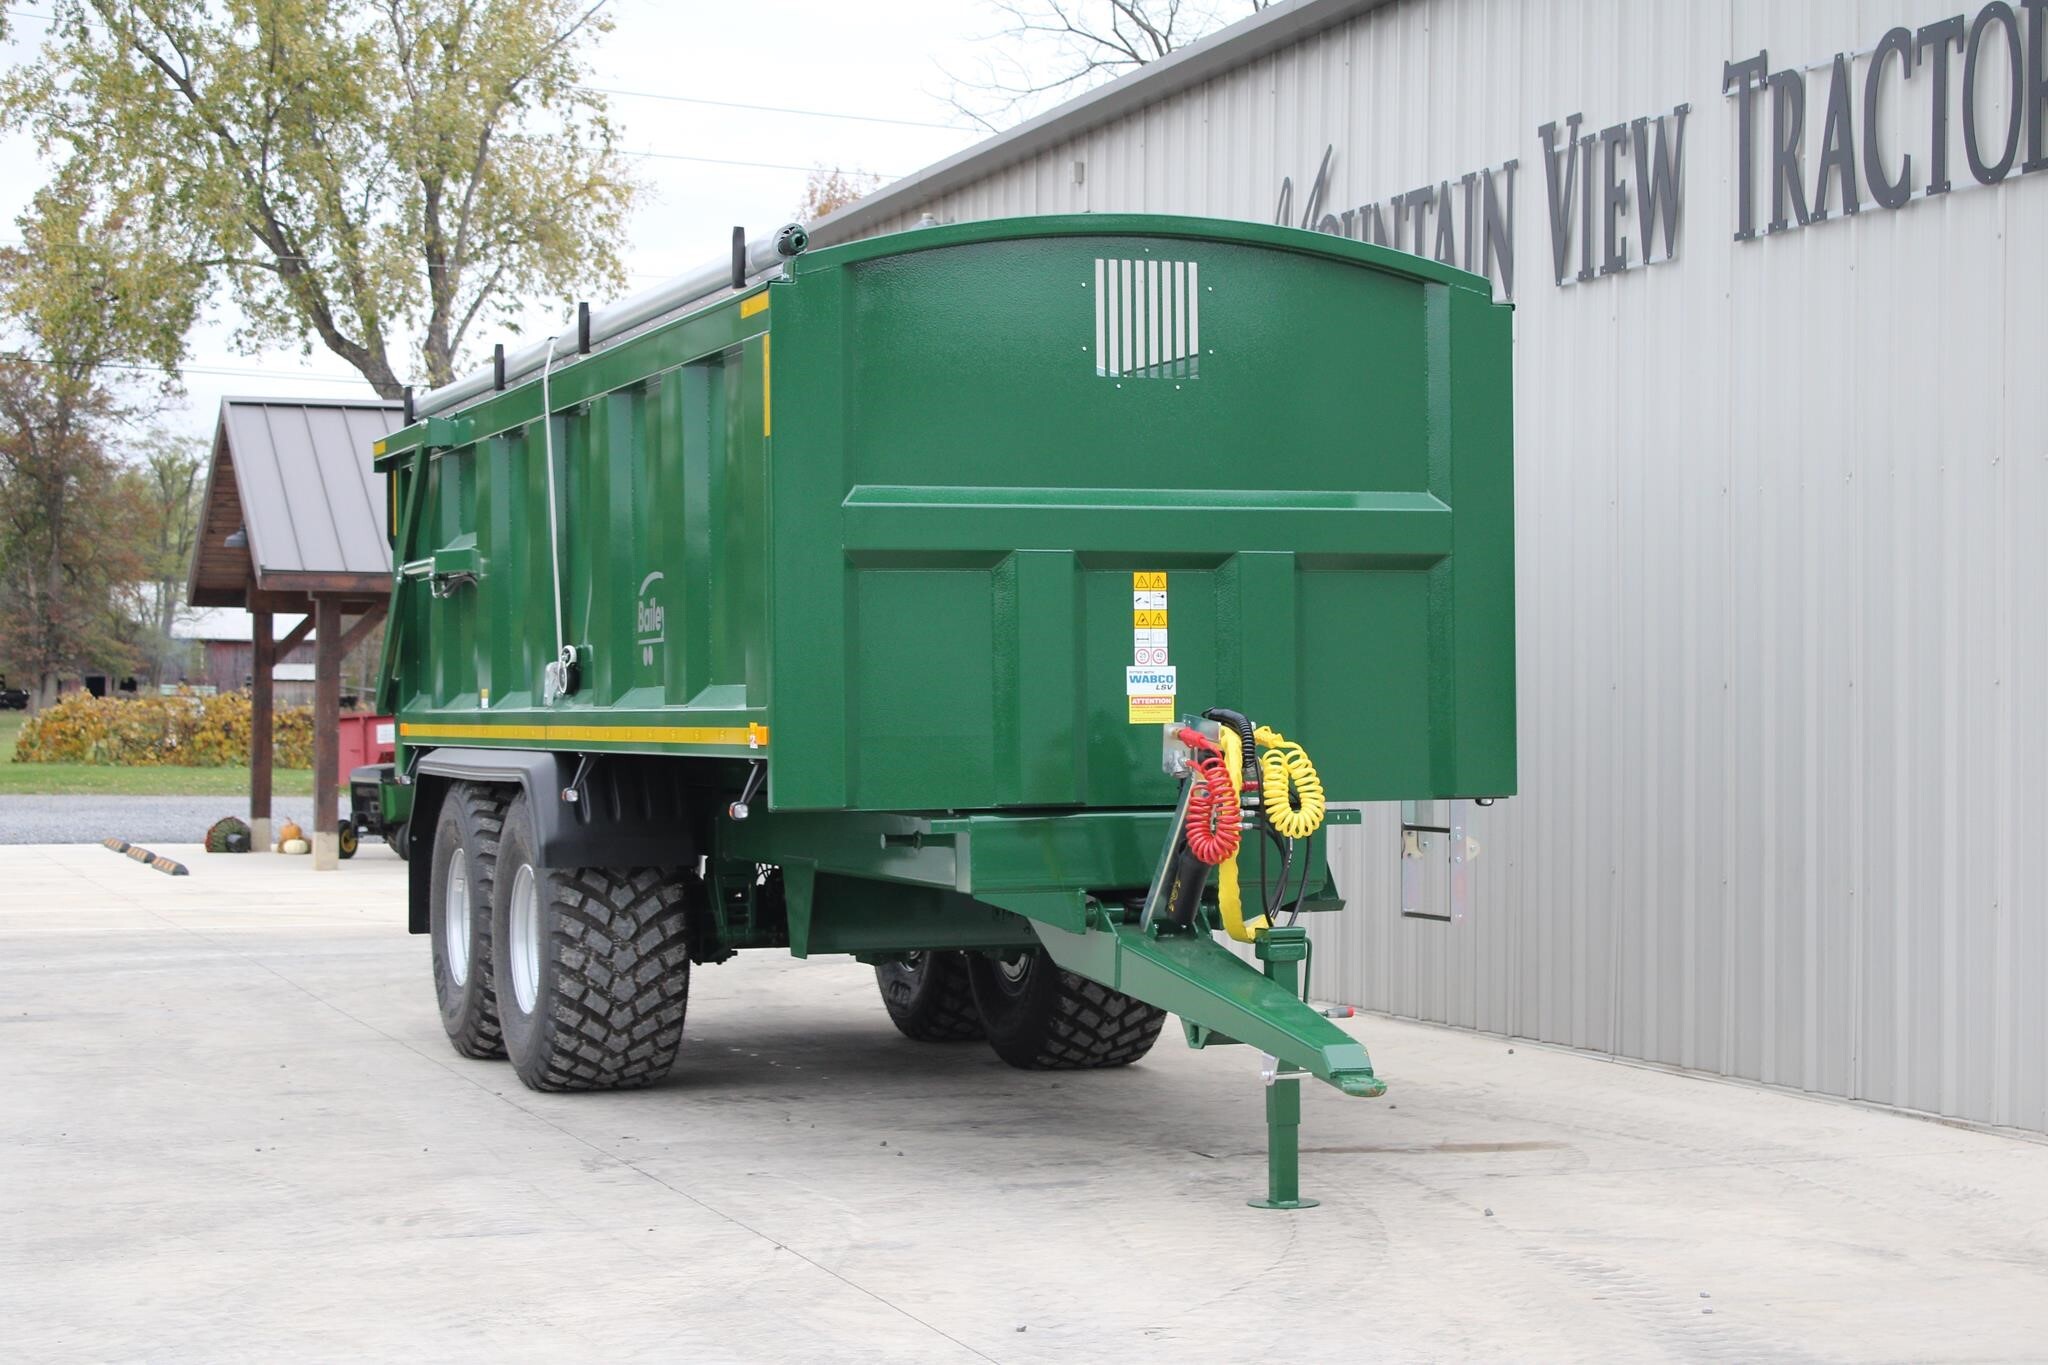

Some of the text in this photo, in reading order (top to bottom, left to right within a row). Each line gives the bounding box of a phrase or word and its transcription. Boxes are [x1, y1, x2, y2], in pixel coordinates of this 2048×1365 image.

[1276, 143, 1518, 300] TAIN
[1538, 103, 1691, 287] VIEW
[1129, 675, 1174, 683] WABCO
